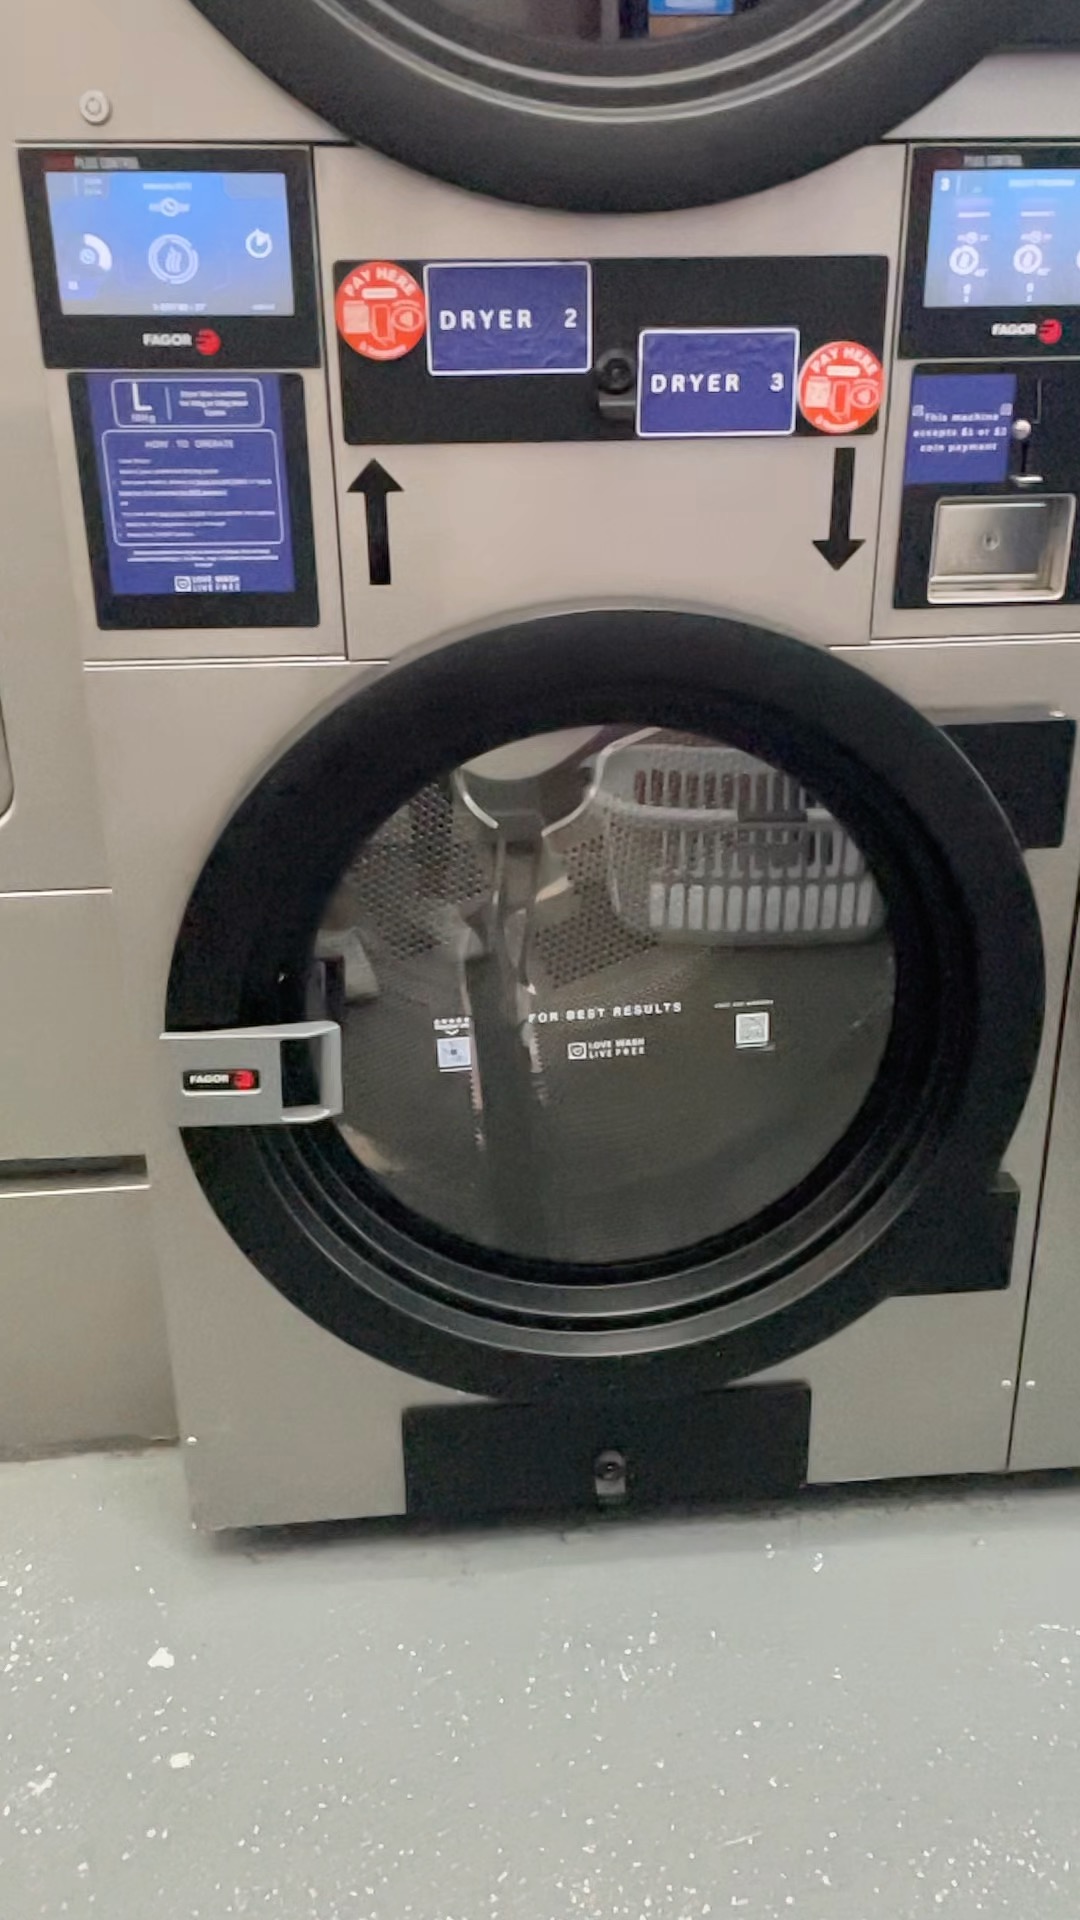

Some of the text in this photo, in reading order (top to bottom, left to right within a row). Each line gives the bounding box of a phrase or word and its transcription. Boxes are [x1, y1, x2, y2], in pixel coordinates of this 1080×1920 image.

[344, 267, 417, 297] PAY HERE
[439, 307, 578, 331] DRYER 2
[990, 323, 1038, 336] FAGOR
[142, 332, 193, 347] FAGOR
[810, 347, 880, 377] PAY HERE
[650, 371, 785, 394] DRYER 3
[131, 382, 153, 411] L
[924, 412, 999, 422] This machine
[912, 428, 958, 439] accepts
[919, 442, 998, 453] coin payment
[528, 1002, 682, 1024] FOR BEST RESULTS
[588, 1037, 646, 1049] LOVE WASH
[188, 1074, 230, 1084] FAGOR
